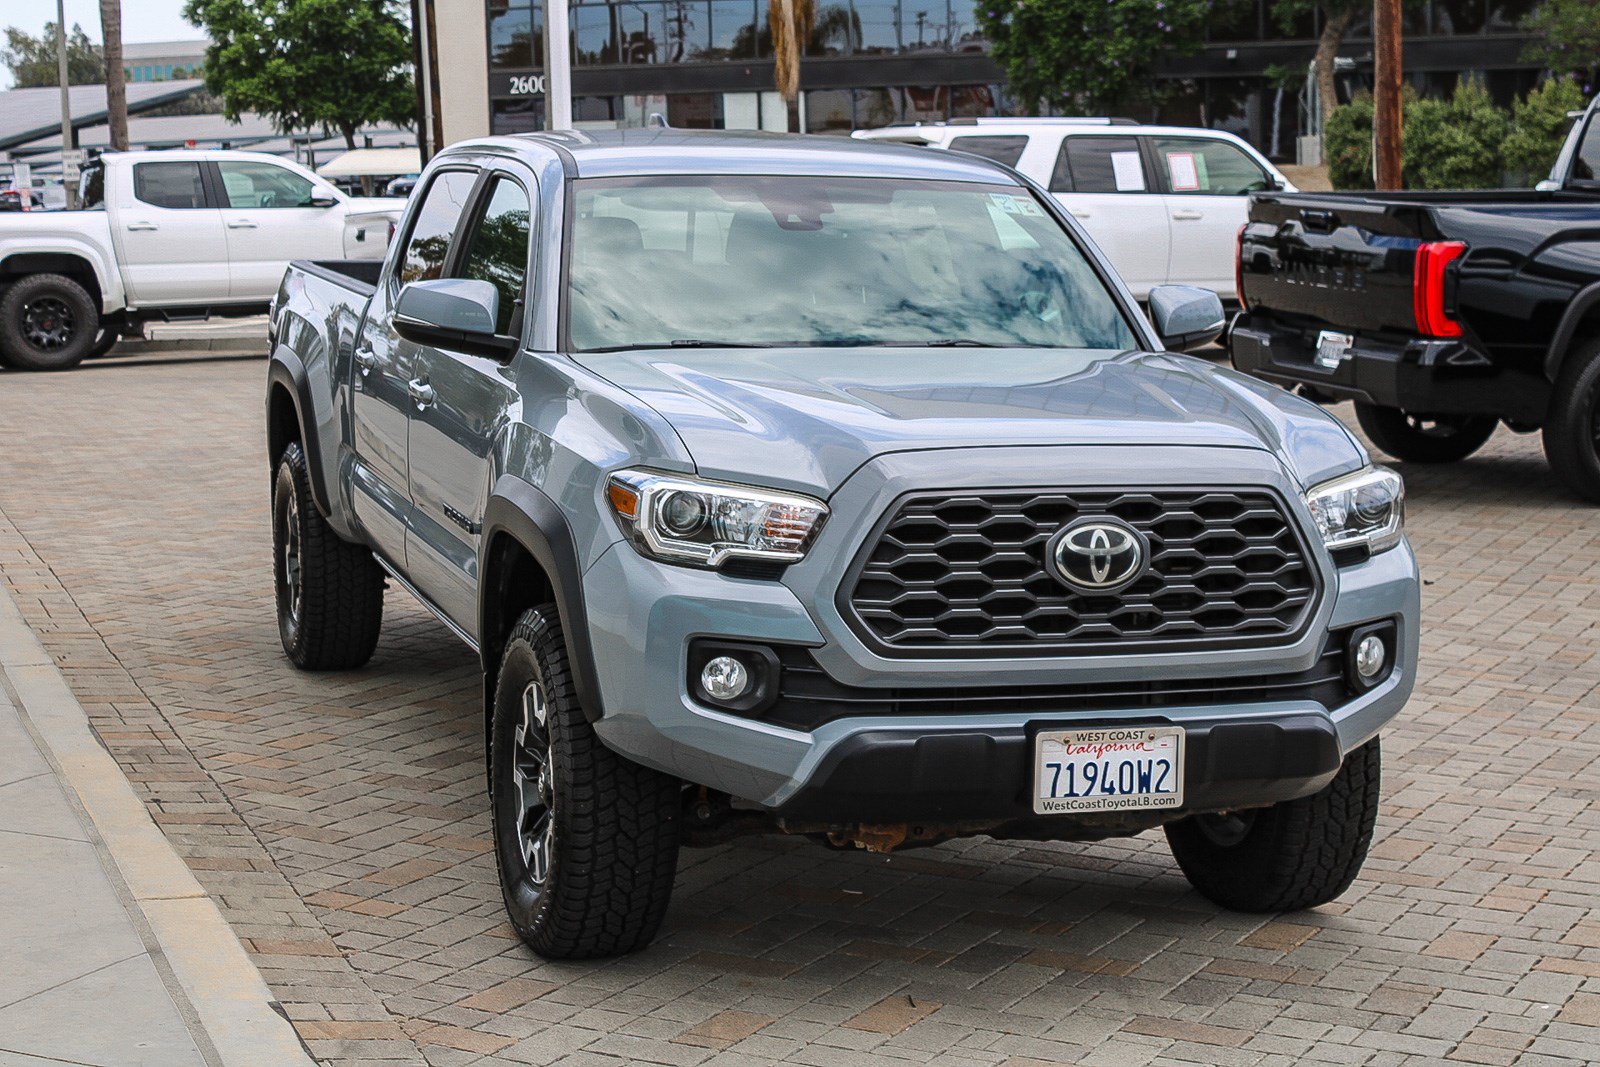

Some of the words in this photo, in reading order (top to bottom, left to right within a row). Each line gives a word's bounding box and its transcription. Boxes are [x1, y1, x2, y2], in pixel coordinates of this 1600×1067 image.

[1076, 732, 1107, 742] WEST
[1109, 730, 1146, 741] COAST
[1066, 741, 1154, 759] California
[1046, 759, 1171, 798] 71940W2
[1043, 797, 1176, 811] WestCoastToyotaLB.com
